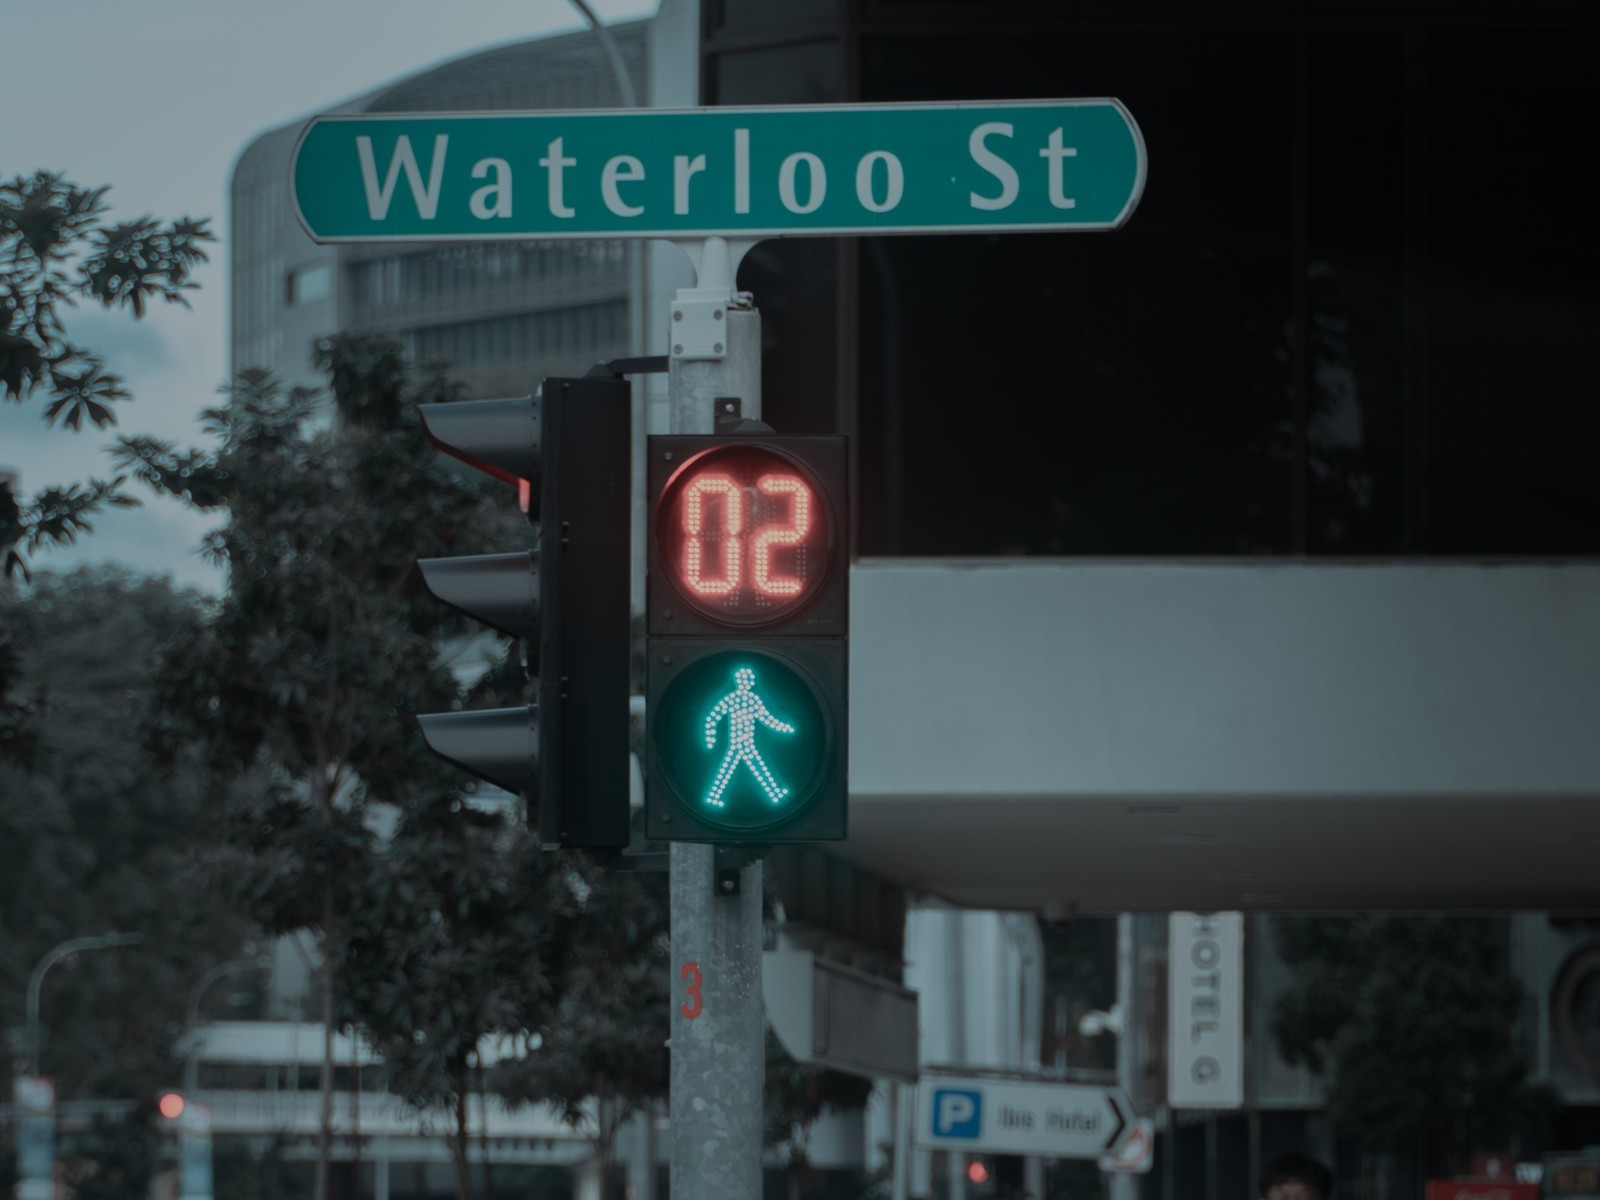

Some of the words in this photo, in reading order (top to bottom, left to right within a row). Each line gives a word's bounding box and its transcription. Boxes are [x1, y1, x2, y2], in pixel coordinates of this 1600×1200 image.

[355, 127, 905, 221] Waterloo
[968, 121, 1078, 211] St
[684, 475, 811, 595] 02
[681, 960, 703, 1020] 3
[1190, 912, 1222, 1045] HOTEL
[938, 1092, 976, 1135] P
[1045, 1106, 1102, 1135] Hotel
